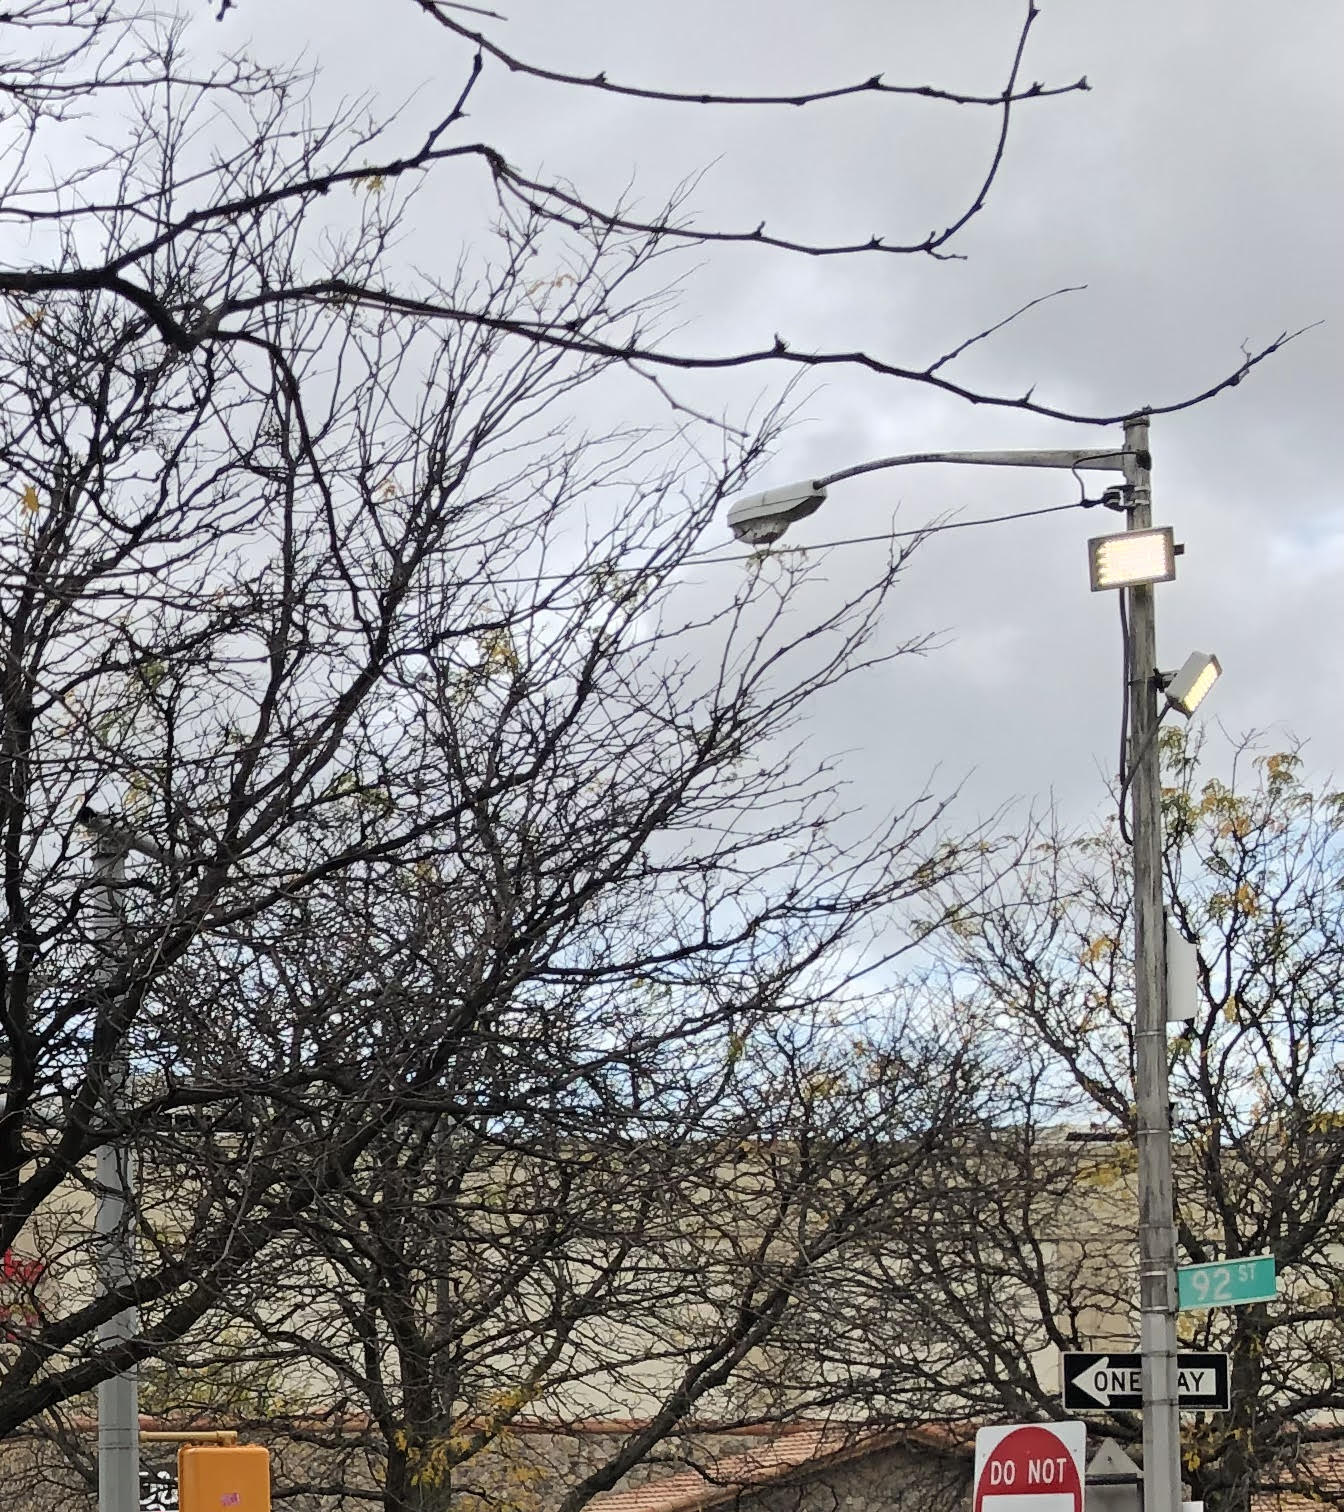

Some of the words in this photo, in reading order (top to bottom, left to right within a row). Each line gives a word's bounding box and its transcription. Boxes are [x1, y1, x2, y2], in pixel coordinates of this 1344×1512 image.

[1192, 1268, 1232, 1301] 92
[1238, 1262, 1257, 1282] ST
[1094, 1371, 1142, 1392] ONE
[1178, 1371, 1205, 1391] AY
[990, 1459, 1016, 1486] DO
[1028, 1457, 1067, 1484] NOT
